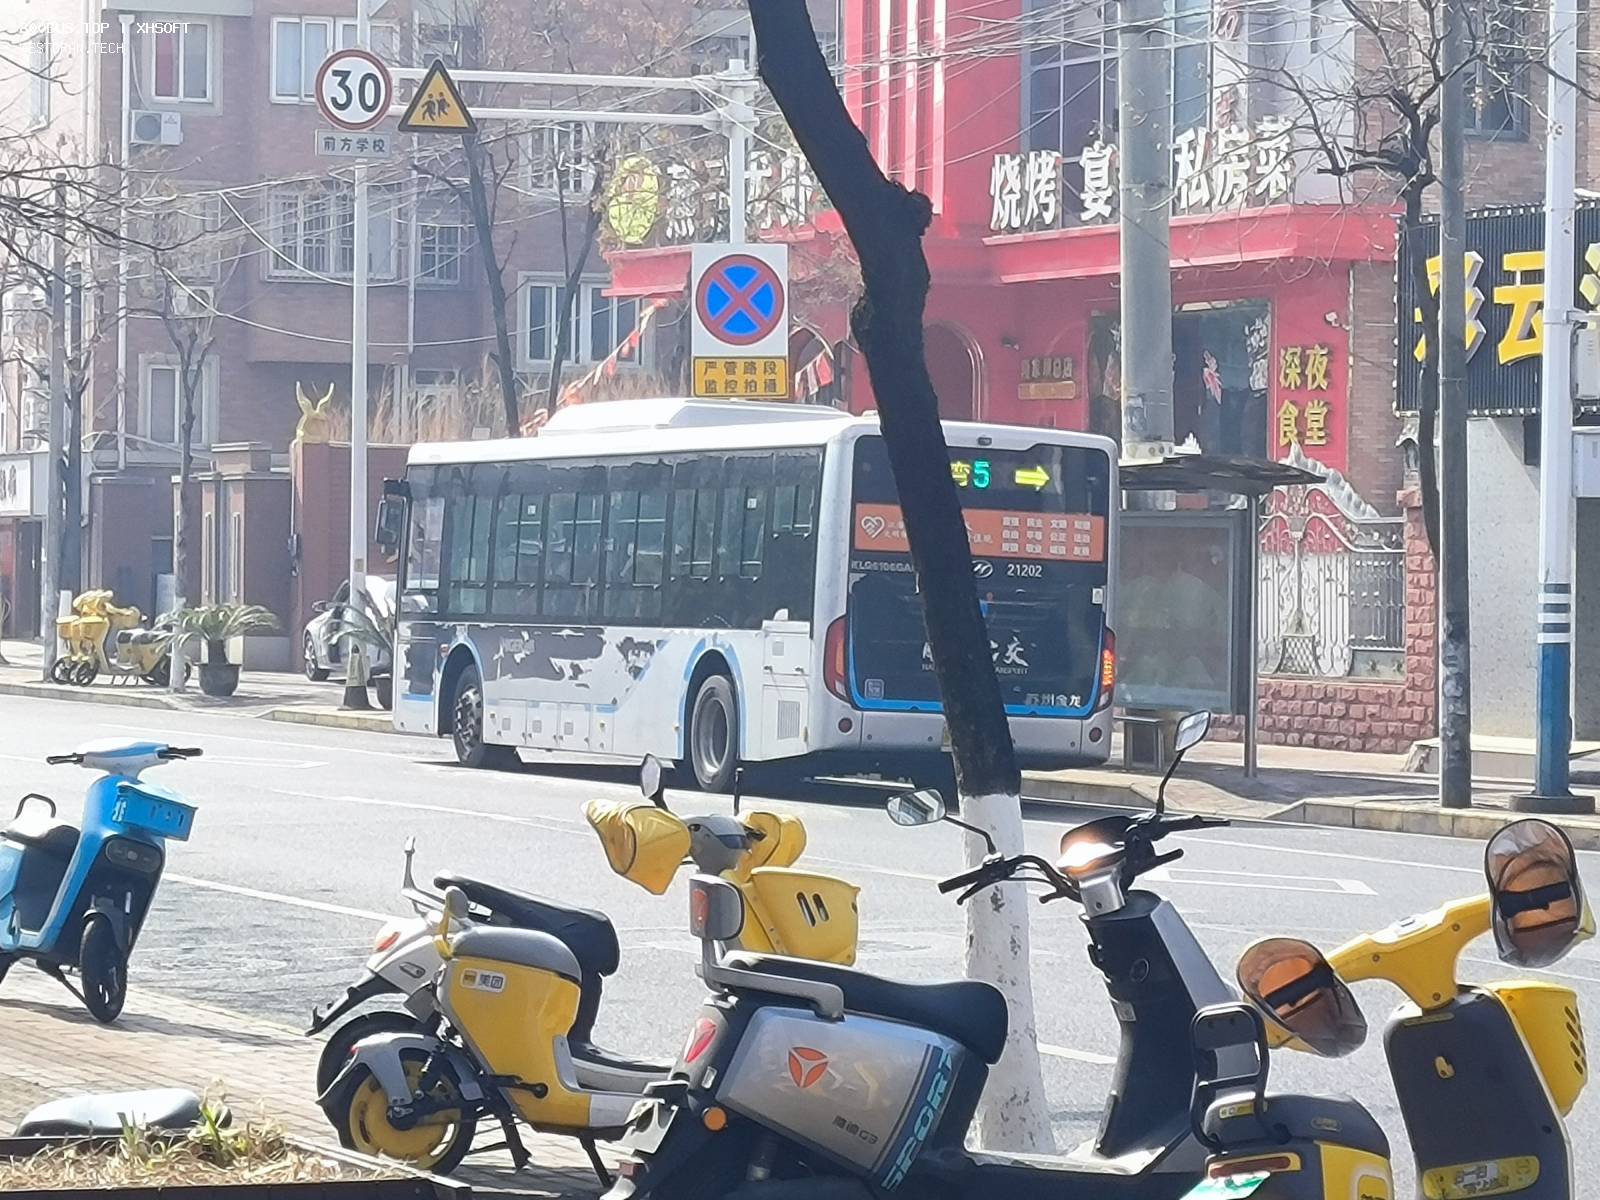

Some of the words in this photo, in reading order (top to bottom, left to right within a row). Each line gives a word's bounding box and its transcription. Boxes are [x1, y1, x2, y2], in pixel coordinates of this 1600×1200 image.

[330, 69, 382, 113] 30
[322, 135, 386, 154] 前方学校
[990, 151, 1061, 230] 烧烤
[1174, 115, 1293, 210] 私房菜
[703, 360, 777, 377] 严管路段
[1279, 344, 1329, 392] 深夜
[703, 378, 777, 394] 监控拍摄
[1277, 399, 1329, 447] 食堂
[851, 559, 915, 573] KLQ6106GA
[1006, 563, 1043, 578] 21202
[880, 1051, 954, 1192] SPORT
